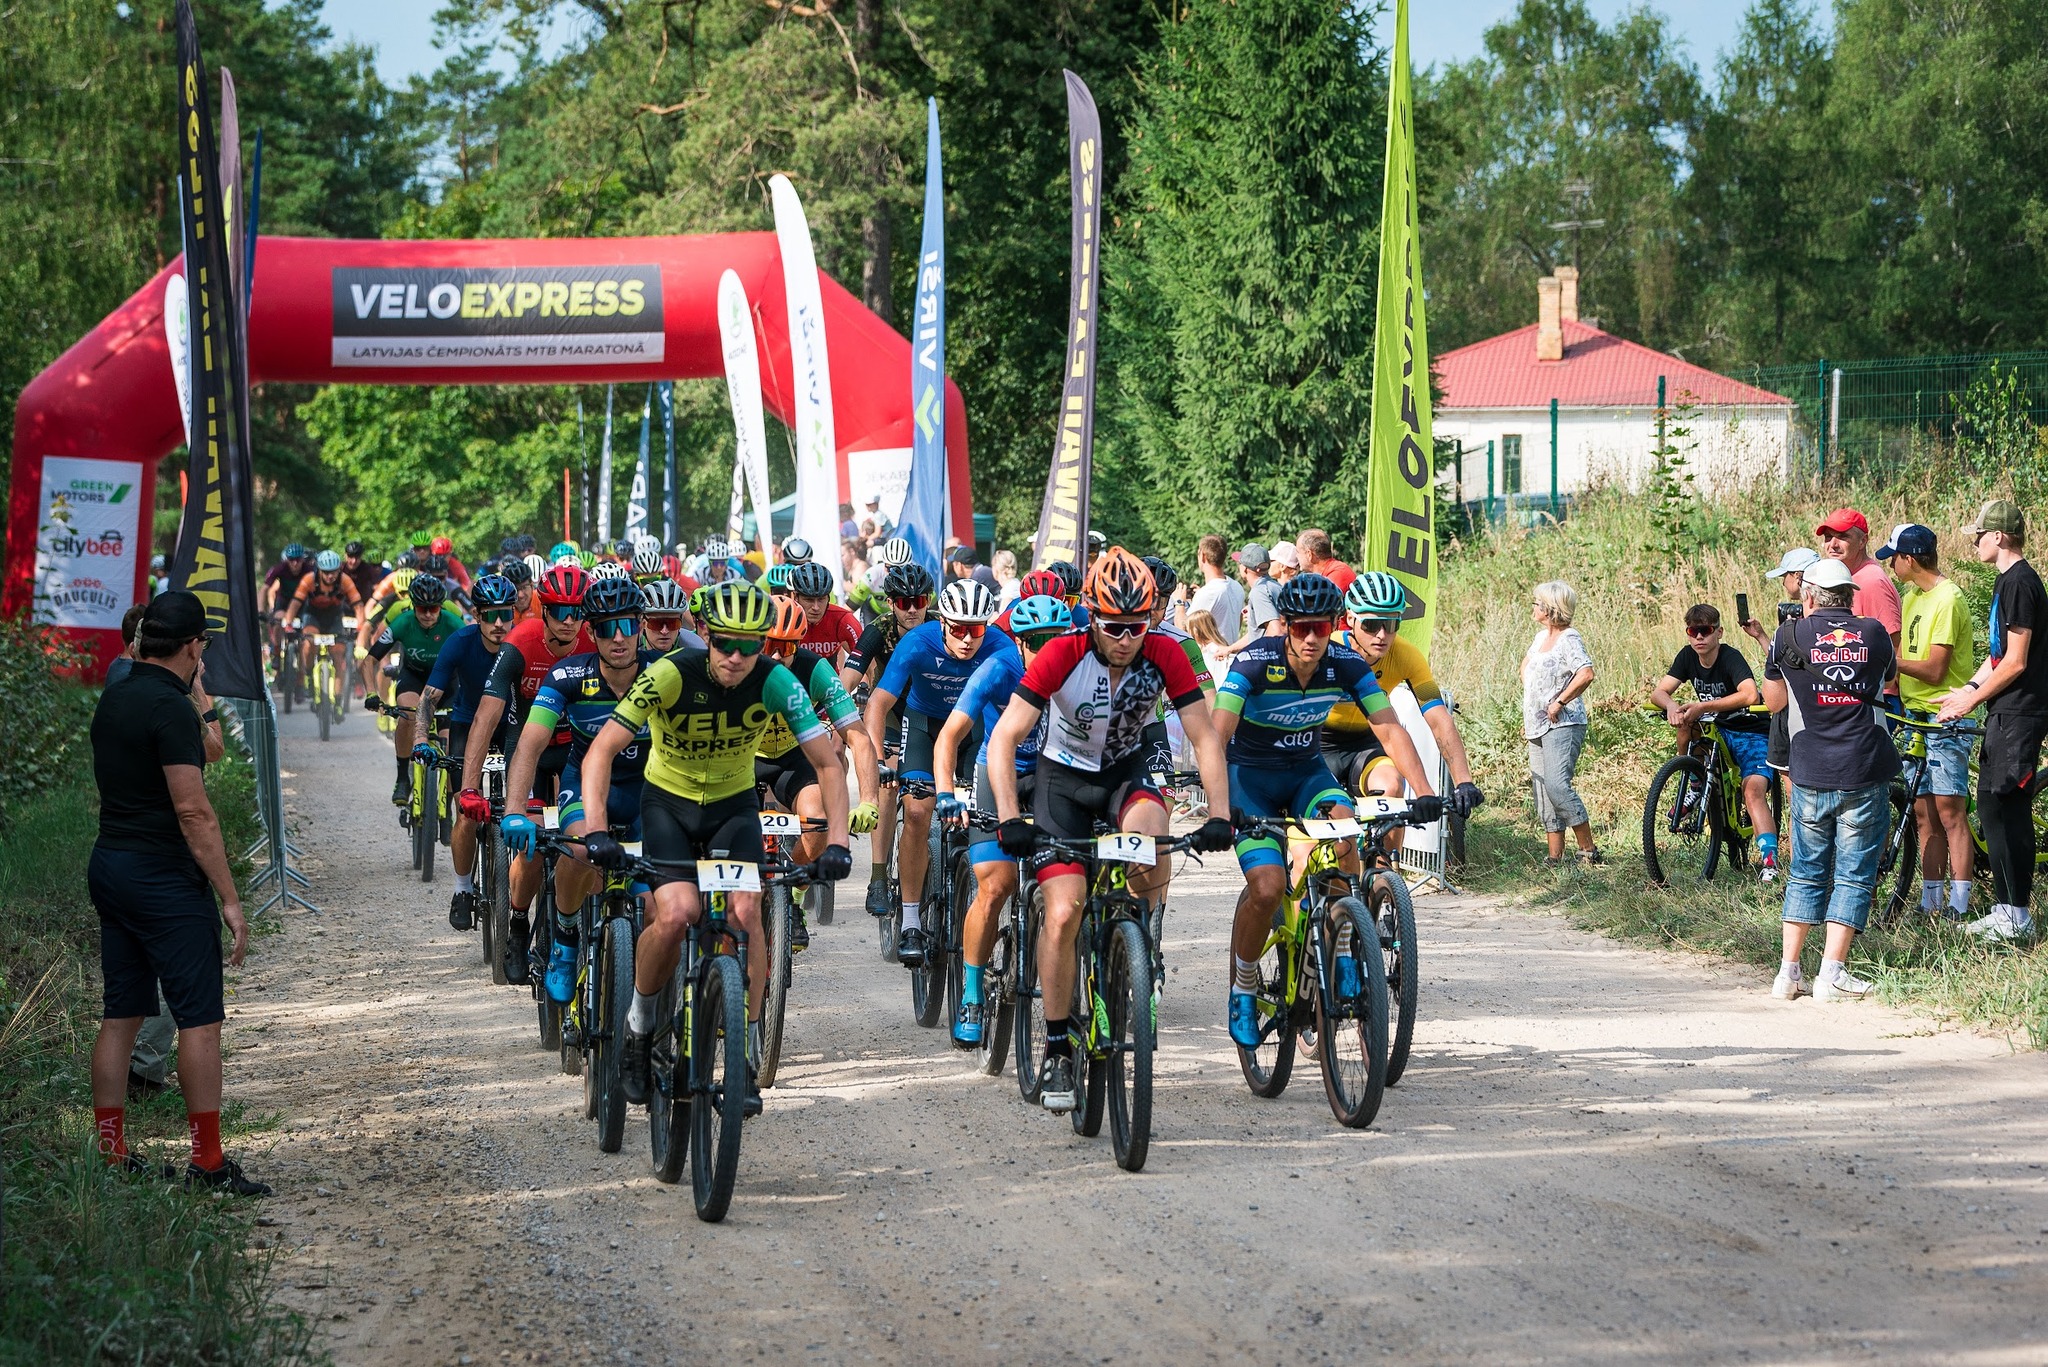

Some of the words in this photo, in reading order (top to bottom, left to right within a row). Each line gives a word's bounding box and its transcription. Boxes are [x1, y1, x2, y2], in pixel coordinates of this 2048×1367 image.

[351, 279, 646, 319] VELOEXPRESS
[352, 346, 423, 359] LATVIJAS
[428, 344, 522, 359] ČEMPIONĀTS
[526, 346, 557, 358] MTB
[562, 341, 646, 356] MARATONĀ
[71, 479, 114, 491] GREEN
[51, 489, 105, 502] MOTORS
[1811, 647, 1839, 664] Red
[1840, 646, 1868, 663] Bull
[921, 672, 970, 683] GIAN
[1812, 682, 1866, 692] INFITI
[1820, 695, 1859, 704] TOTAL
[662, 731, 765, 753] EXPRES
[620, 745, 639, 760] tg
[485, 756, 507, 766] 28
[1148, 764, 1166, 772] IGA
[1376, 799, 1390, 812] 5
[763, 815, 790, 827] 20
[1326, 822, 1336, 831] 1
[1114, 836, 1143, 851] 19
[714, 863, 744, 879] 17
